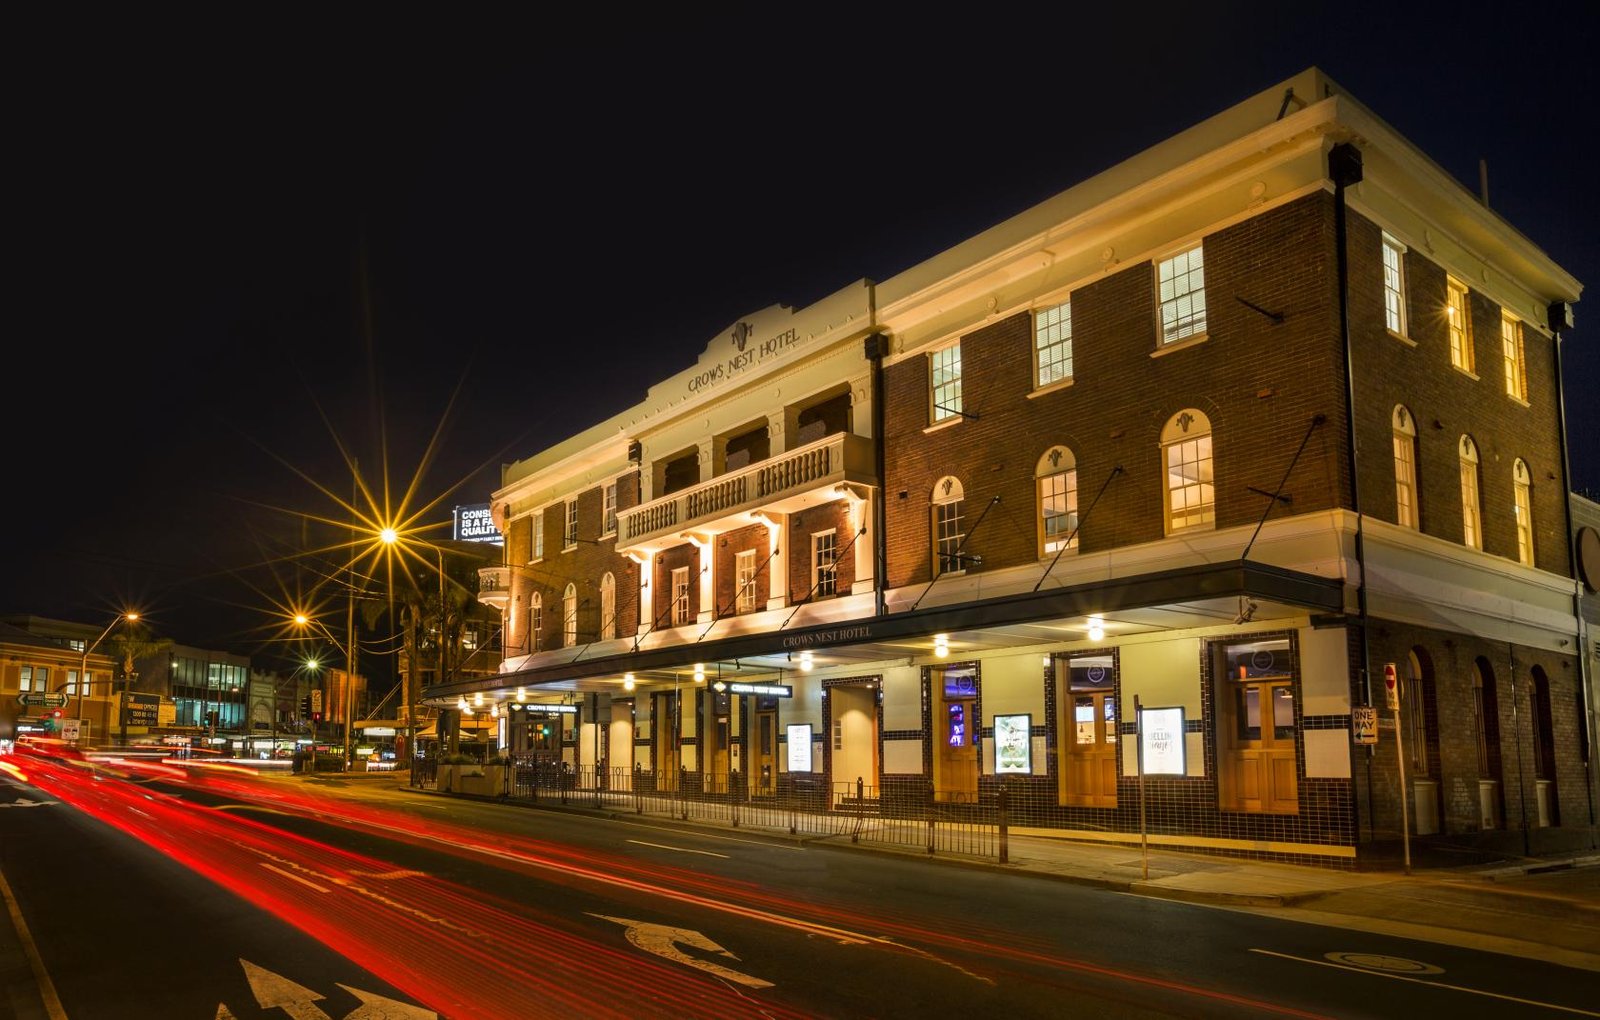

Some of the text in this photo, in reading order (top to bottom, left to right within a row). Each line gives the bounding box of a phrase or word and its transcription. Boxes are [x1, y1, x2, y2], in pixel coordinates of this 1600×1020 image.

[728, 348, 755, 373] NEST
[760, 328, 800, 358] HOTEL
[462, 519, 472, 528] IS
[473, 519, 480, 527] A
[461, 526, 500, 536] QUALIT
[783, 627, 871, 647] CROWS NEST HOTEL
[1354, 712, 1372, 720] ONE
[1354, 721, 1374, 729] WAY
